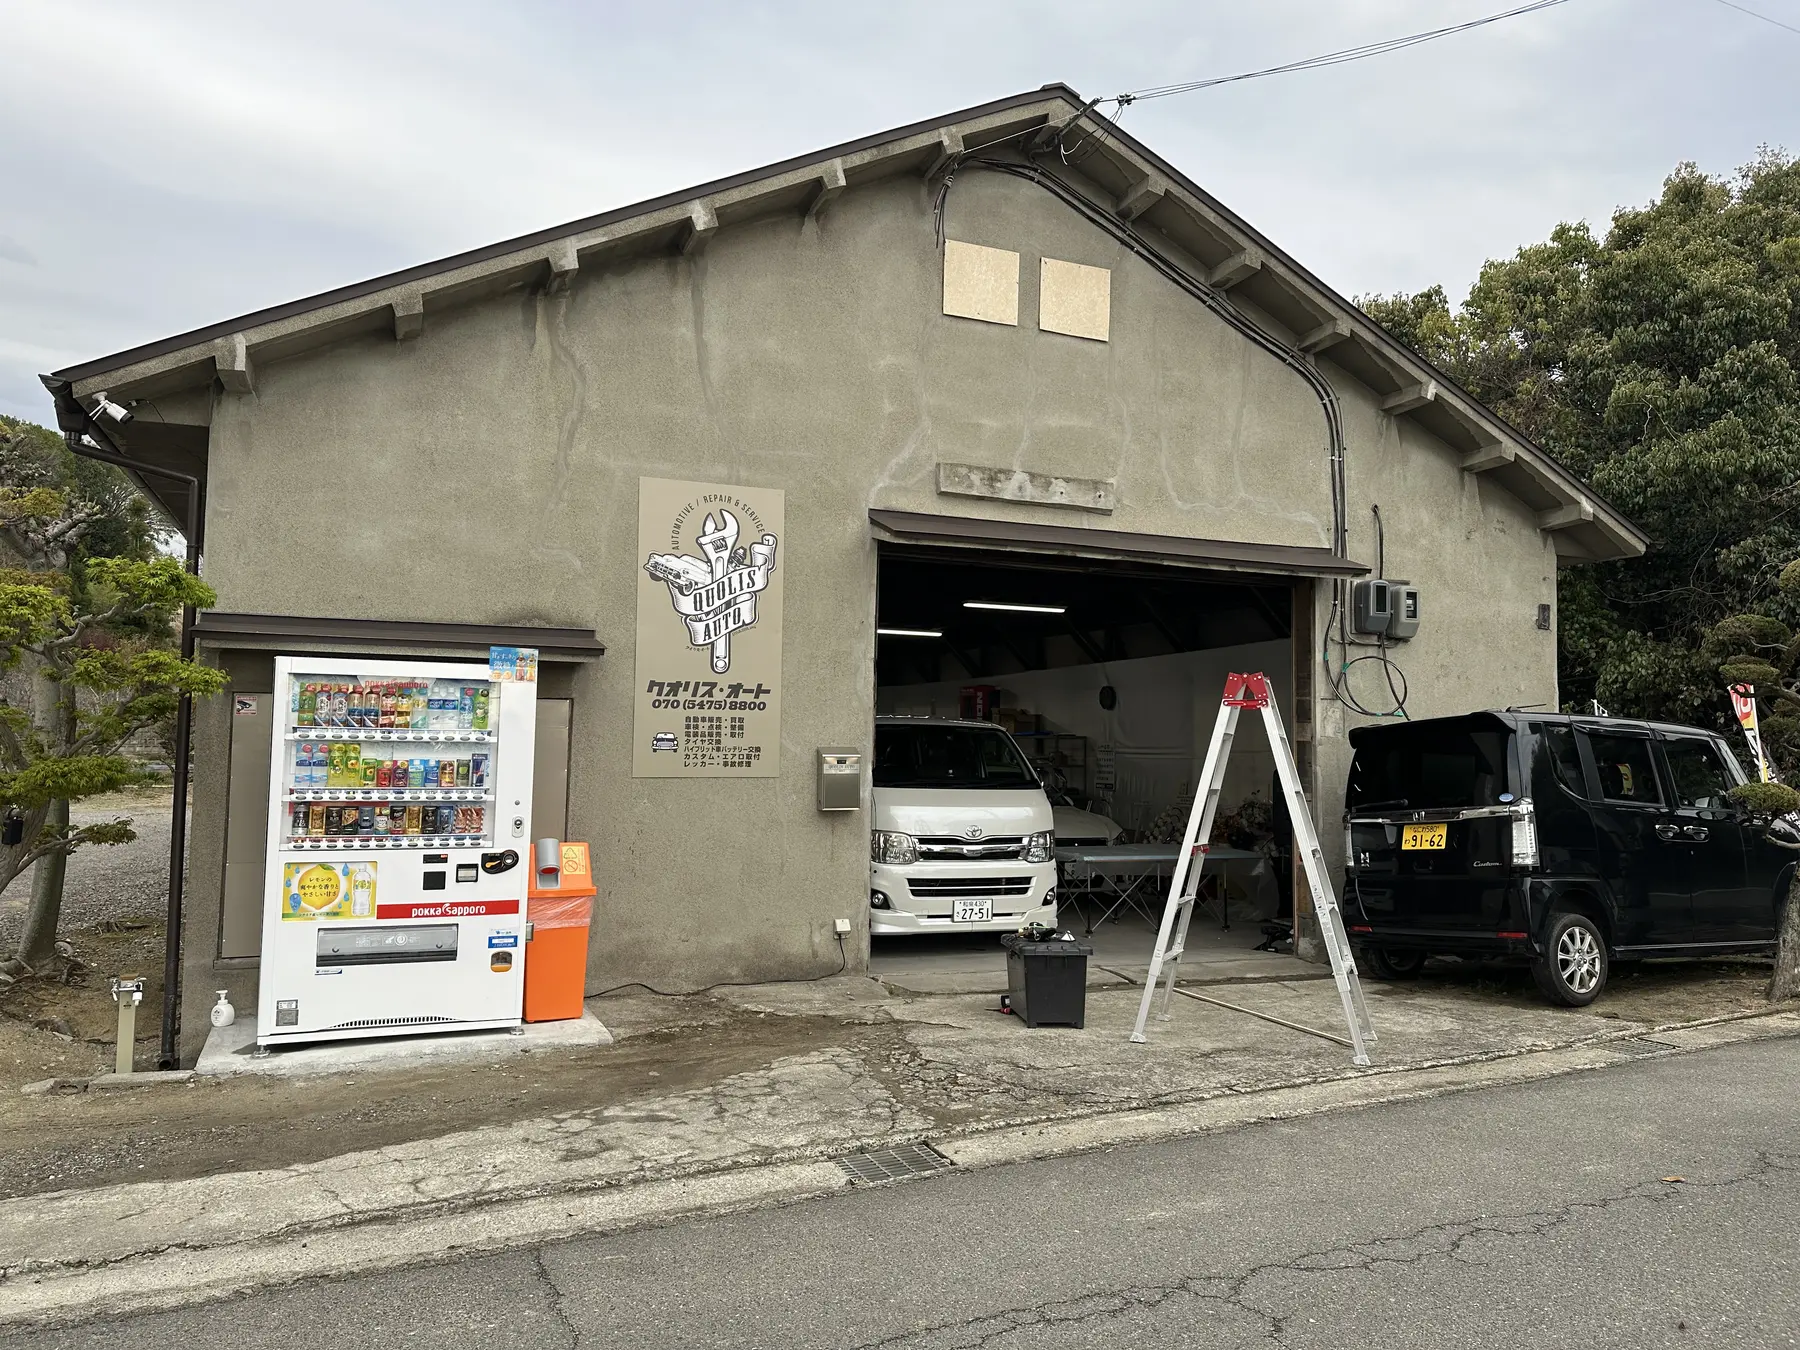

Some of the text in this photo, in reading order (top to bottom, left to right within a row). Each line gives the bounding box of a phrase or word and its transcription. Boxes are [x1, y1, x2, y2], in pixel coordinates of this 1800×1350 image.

[671, 502, 695, 551] AUTOMOTIVE
[703, 494, 732, 504] REPAIR
[740, 503, 765, 534] SERVICE
[692, 570, 757, 612] QUOLIS
[702, 607, 742, 642] AUTO
[646, 680, 771, 700] クオリス・オート
[684, 716, 744, 724] 自動車販売・買取
[684, 731, 745, 739] 電装品販売・取付
[684, 753, 760, 761] カスタム・エアロ取付
[1411, 834, 1443, 848] 91-62
[961, 908, 989, 920] 27-51
